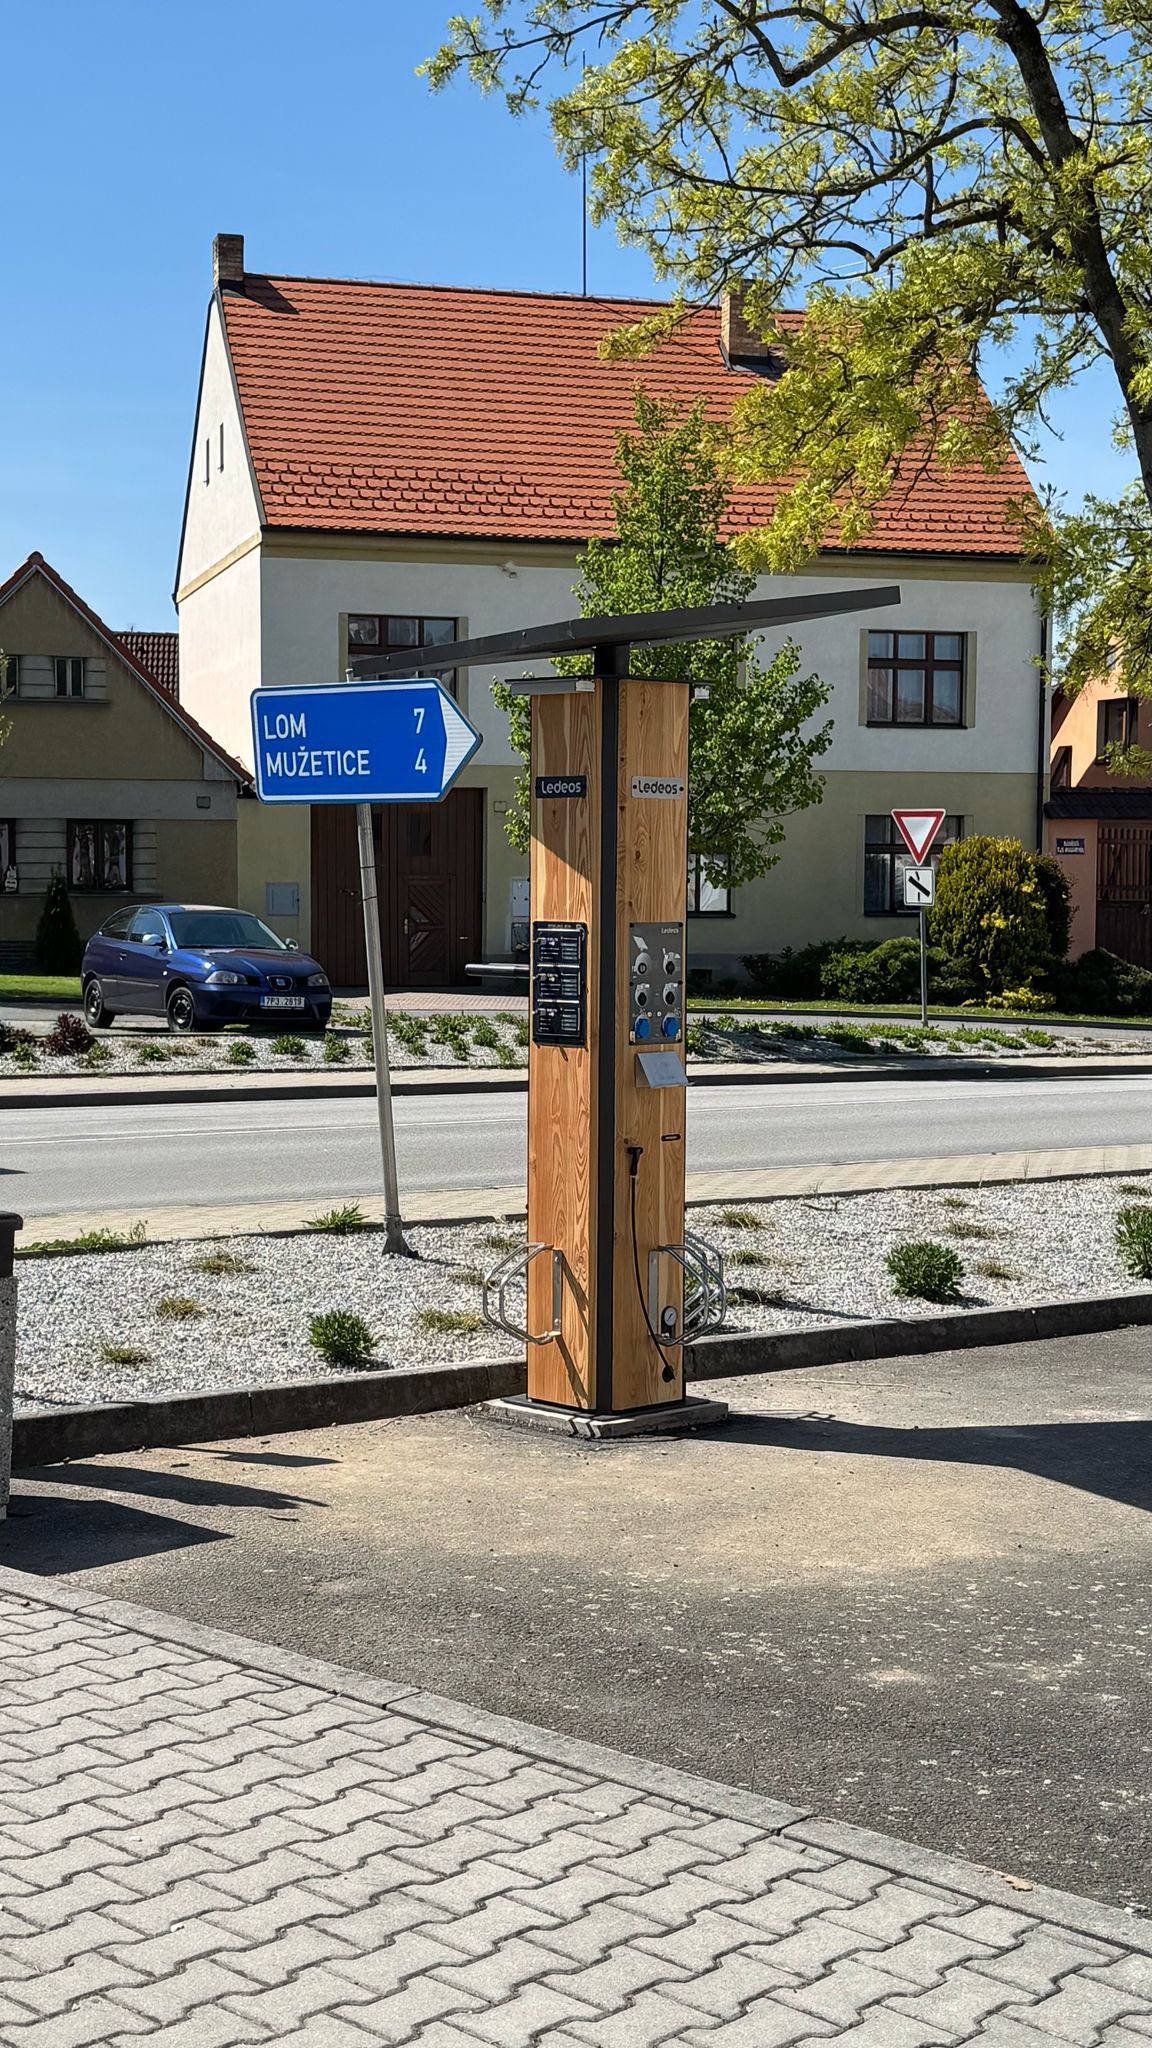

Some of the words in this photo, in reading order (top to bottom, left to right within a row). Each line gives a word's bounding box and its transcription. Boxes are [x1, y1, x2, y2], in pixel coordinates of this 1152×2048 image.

[264, 713, 306, 739] LOM
[413, 708, 425, 735] 7
[266, 746, 370, 776] MUŽETICE
[414, 748, 427, 774] 4
[541, 780, 581, 794] Ledeos
[638, 780, 678, 795] Ledeos
